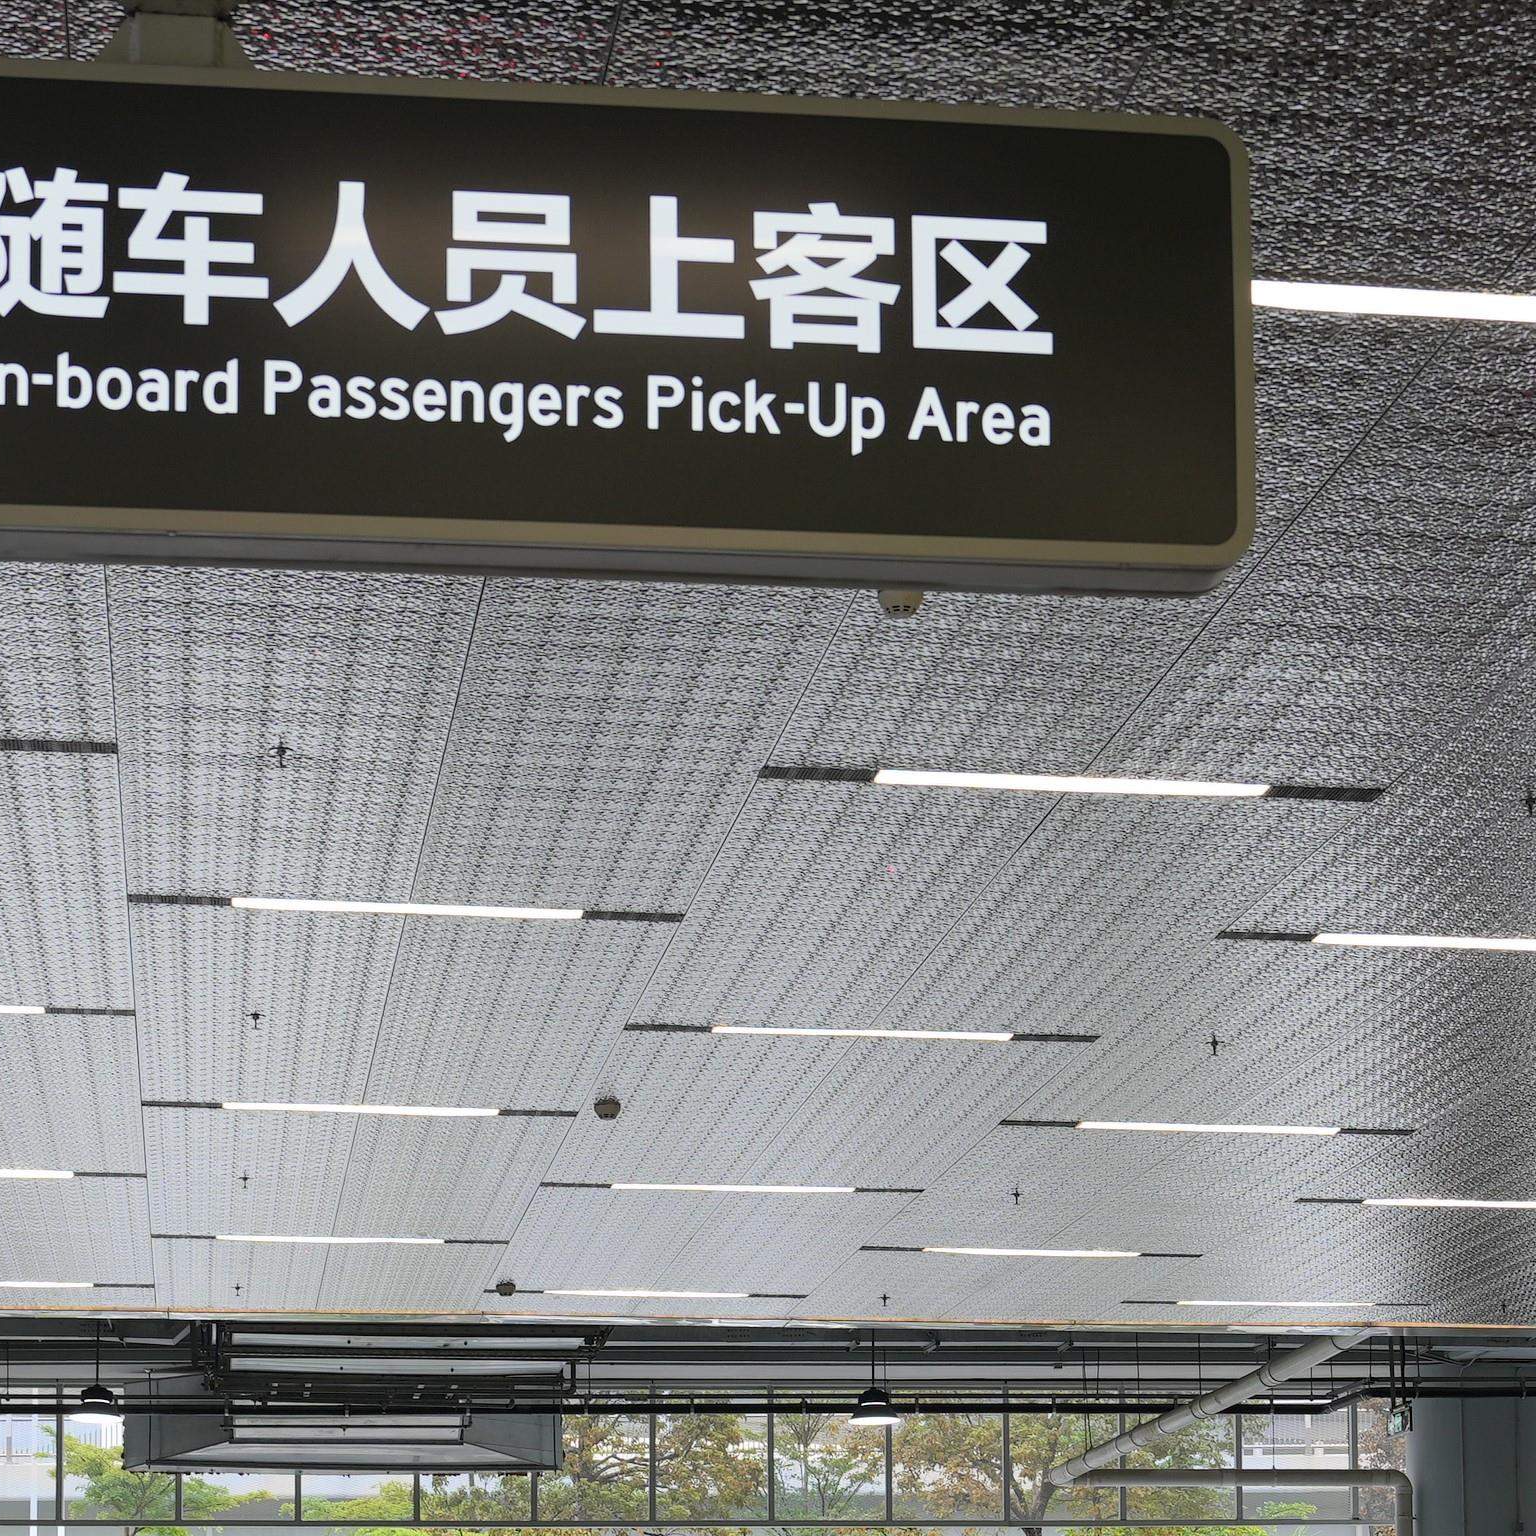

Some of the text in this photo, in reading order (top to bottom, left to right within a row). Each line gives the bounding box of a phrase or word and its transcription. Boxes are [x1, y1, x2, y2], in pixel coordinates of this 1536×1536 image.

[263, 359, 624, 442] Passengers
[647, 374, 886, 455] Pick-Up
[907, 387, 1051, 446] Area
